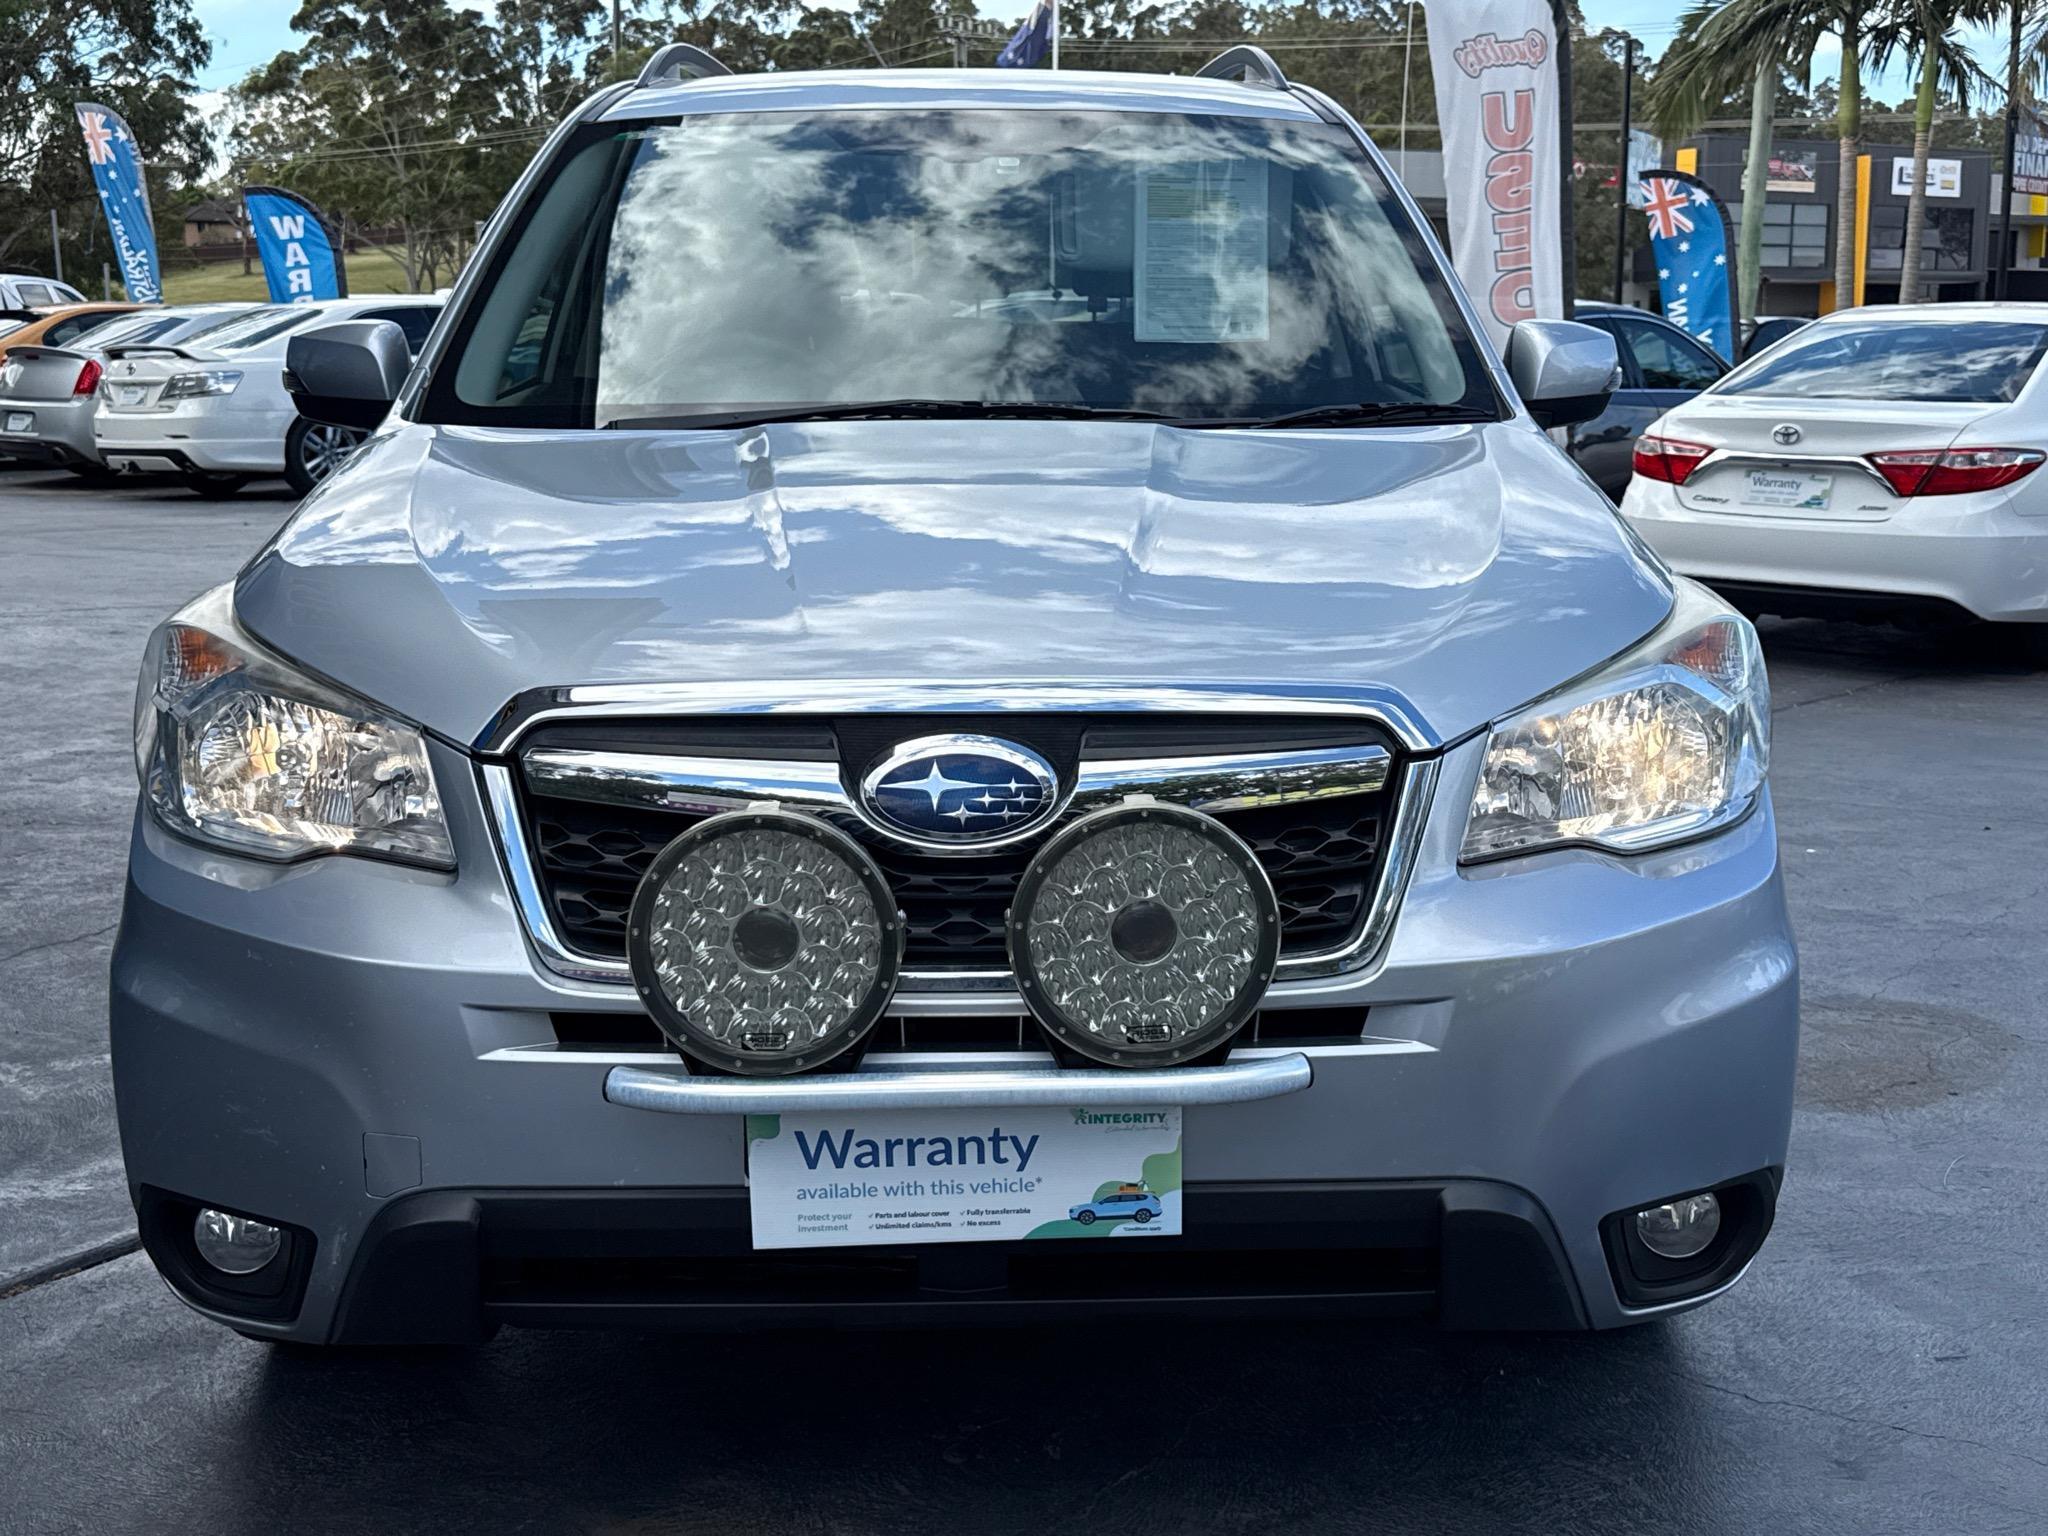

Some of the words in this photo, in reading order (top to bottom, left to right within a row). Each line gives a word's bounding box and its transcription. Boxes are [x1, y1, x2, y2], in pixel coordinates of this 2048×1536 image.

[1752, 476, 1802, 491] Warranty
[1088, 1113, 1167, 1124] INTEGRITY
[794, 1127, 1040, 1172] Warranty
[796, 1181, 878, 1200] available
[883, 1179, 925, 1197] with
[930, 1179, 965, 1196] this
[798, 1213, 831, 1222] Protect
[831, 1213, 852, 1222] your
[893, 1210, 907, 1218] and
[966, 1208, 984, 1217] Fully
[875, 1222, 910, 1230] Unlimited
